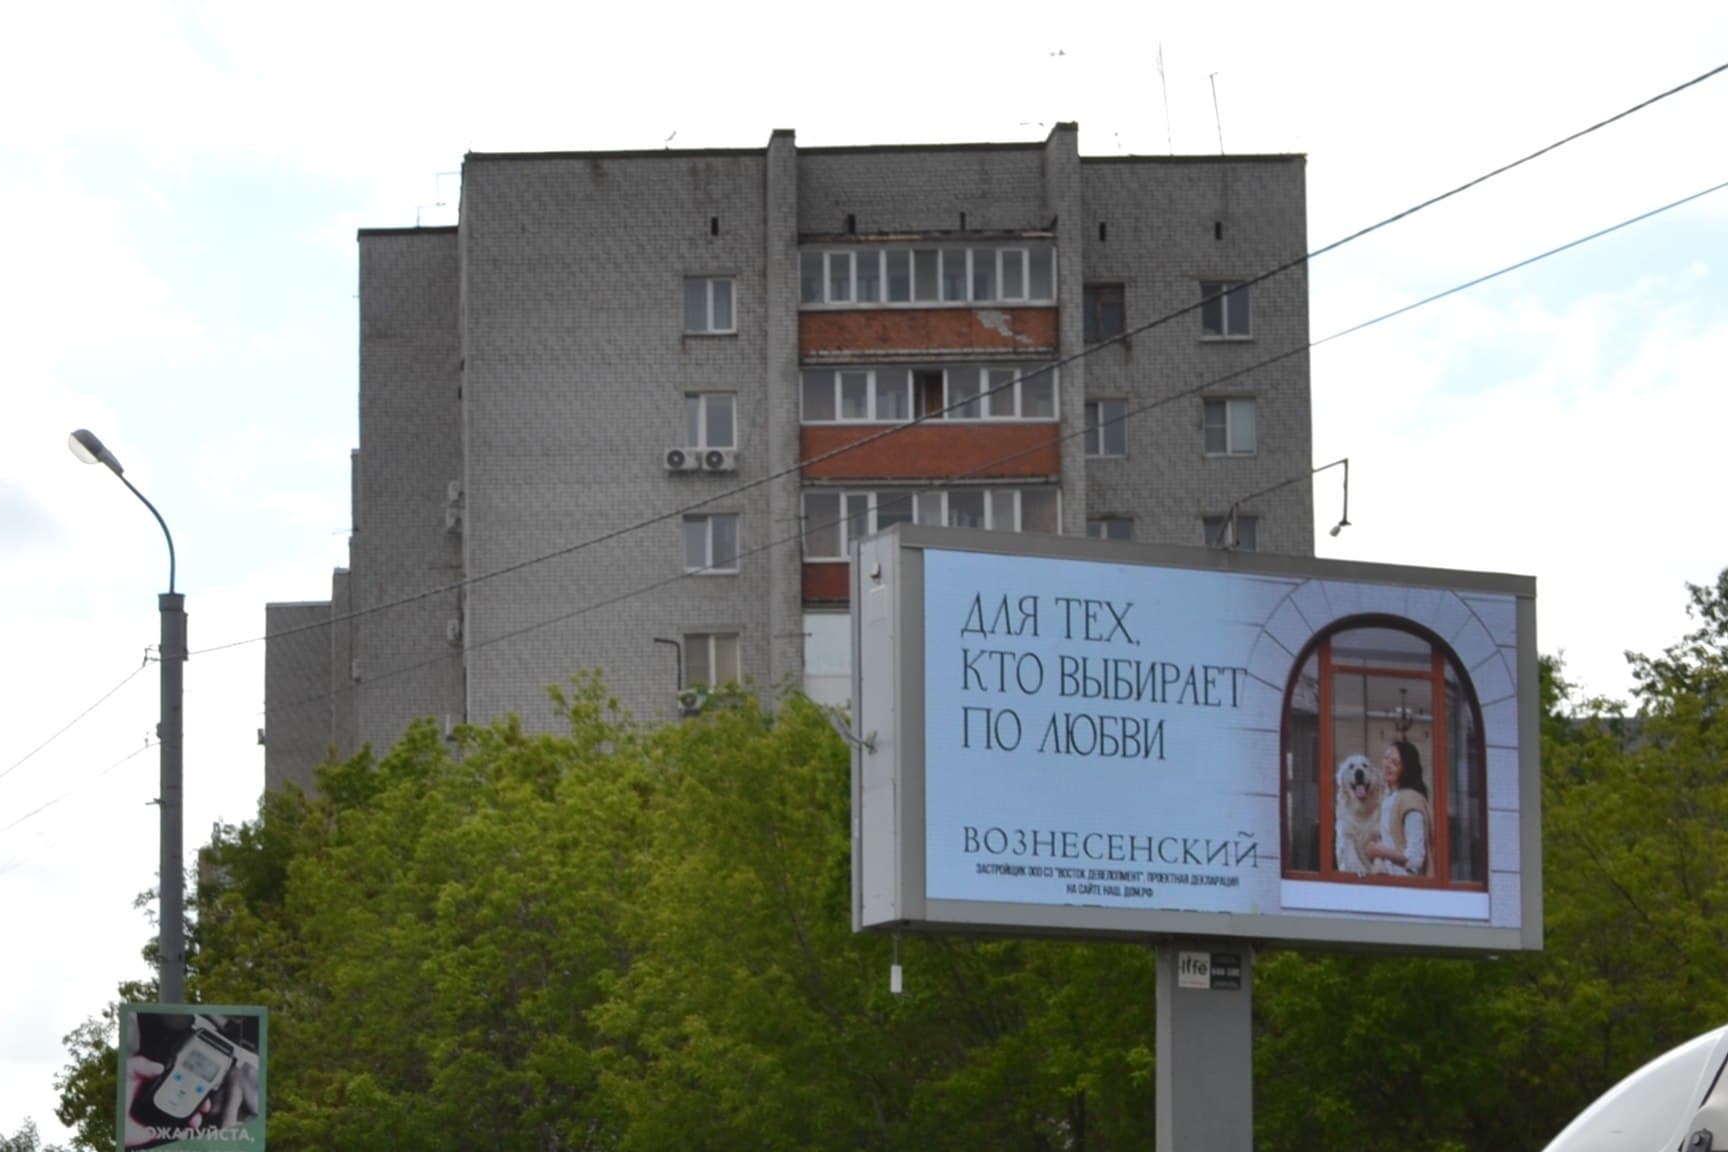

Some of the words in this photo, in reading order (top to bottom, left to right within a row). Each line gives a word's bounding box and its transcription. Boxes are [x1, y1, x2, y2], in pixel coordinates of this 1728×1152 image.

[961, 591, 1039, 640] ДЛЯ
[1055, 597, 1141, 647] ТЕХ,
[961, 648, 1044, 695] КТО
[1059, 654, 1248, 708] ВЫБИРАЕТ
[962, 706, 1022, 752] ПО
[1037, 711, 1167, 761] ЛЮБВИ
[963, 826, 1260, 869] ВОЗНЕСЕНСКИЙ
[142, 1126, 255, 1143] ОЖАЛУЙСТА,
